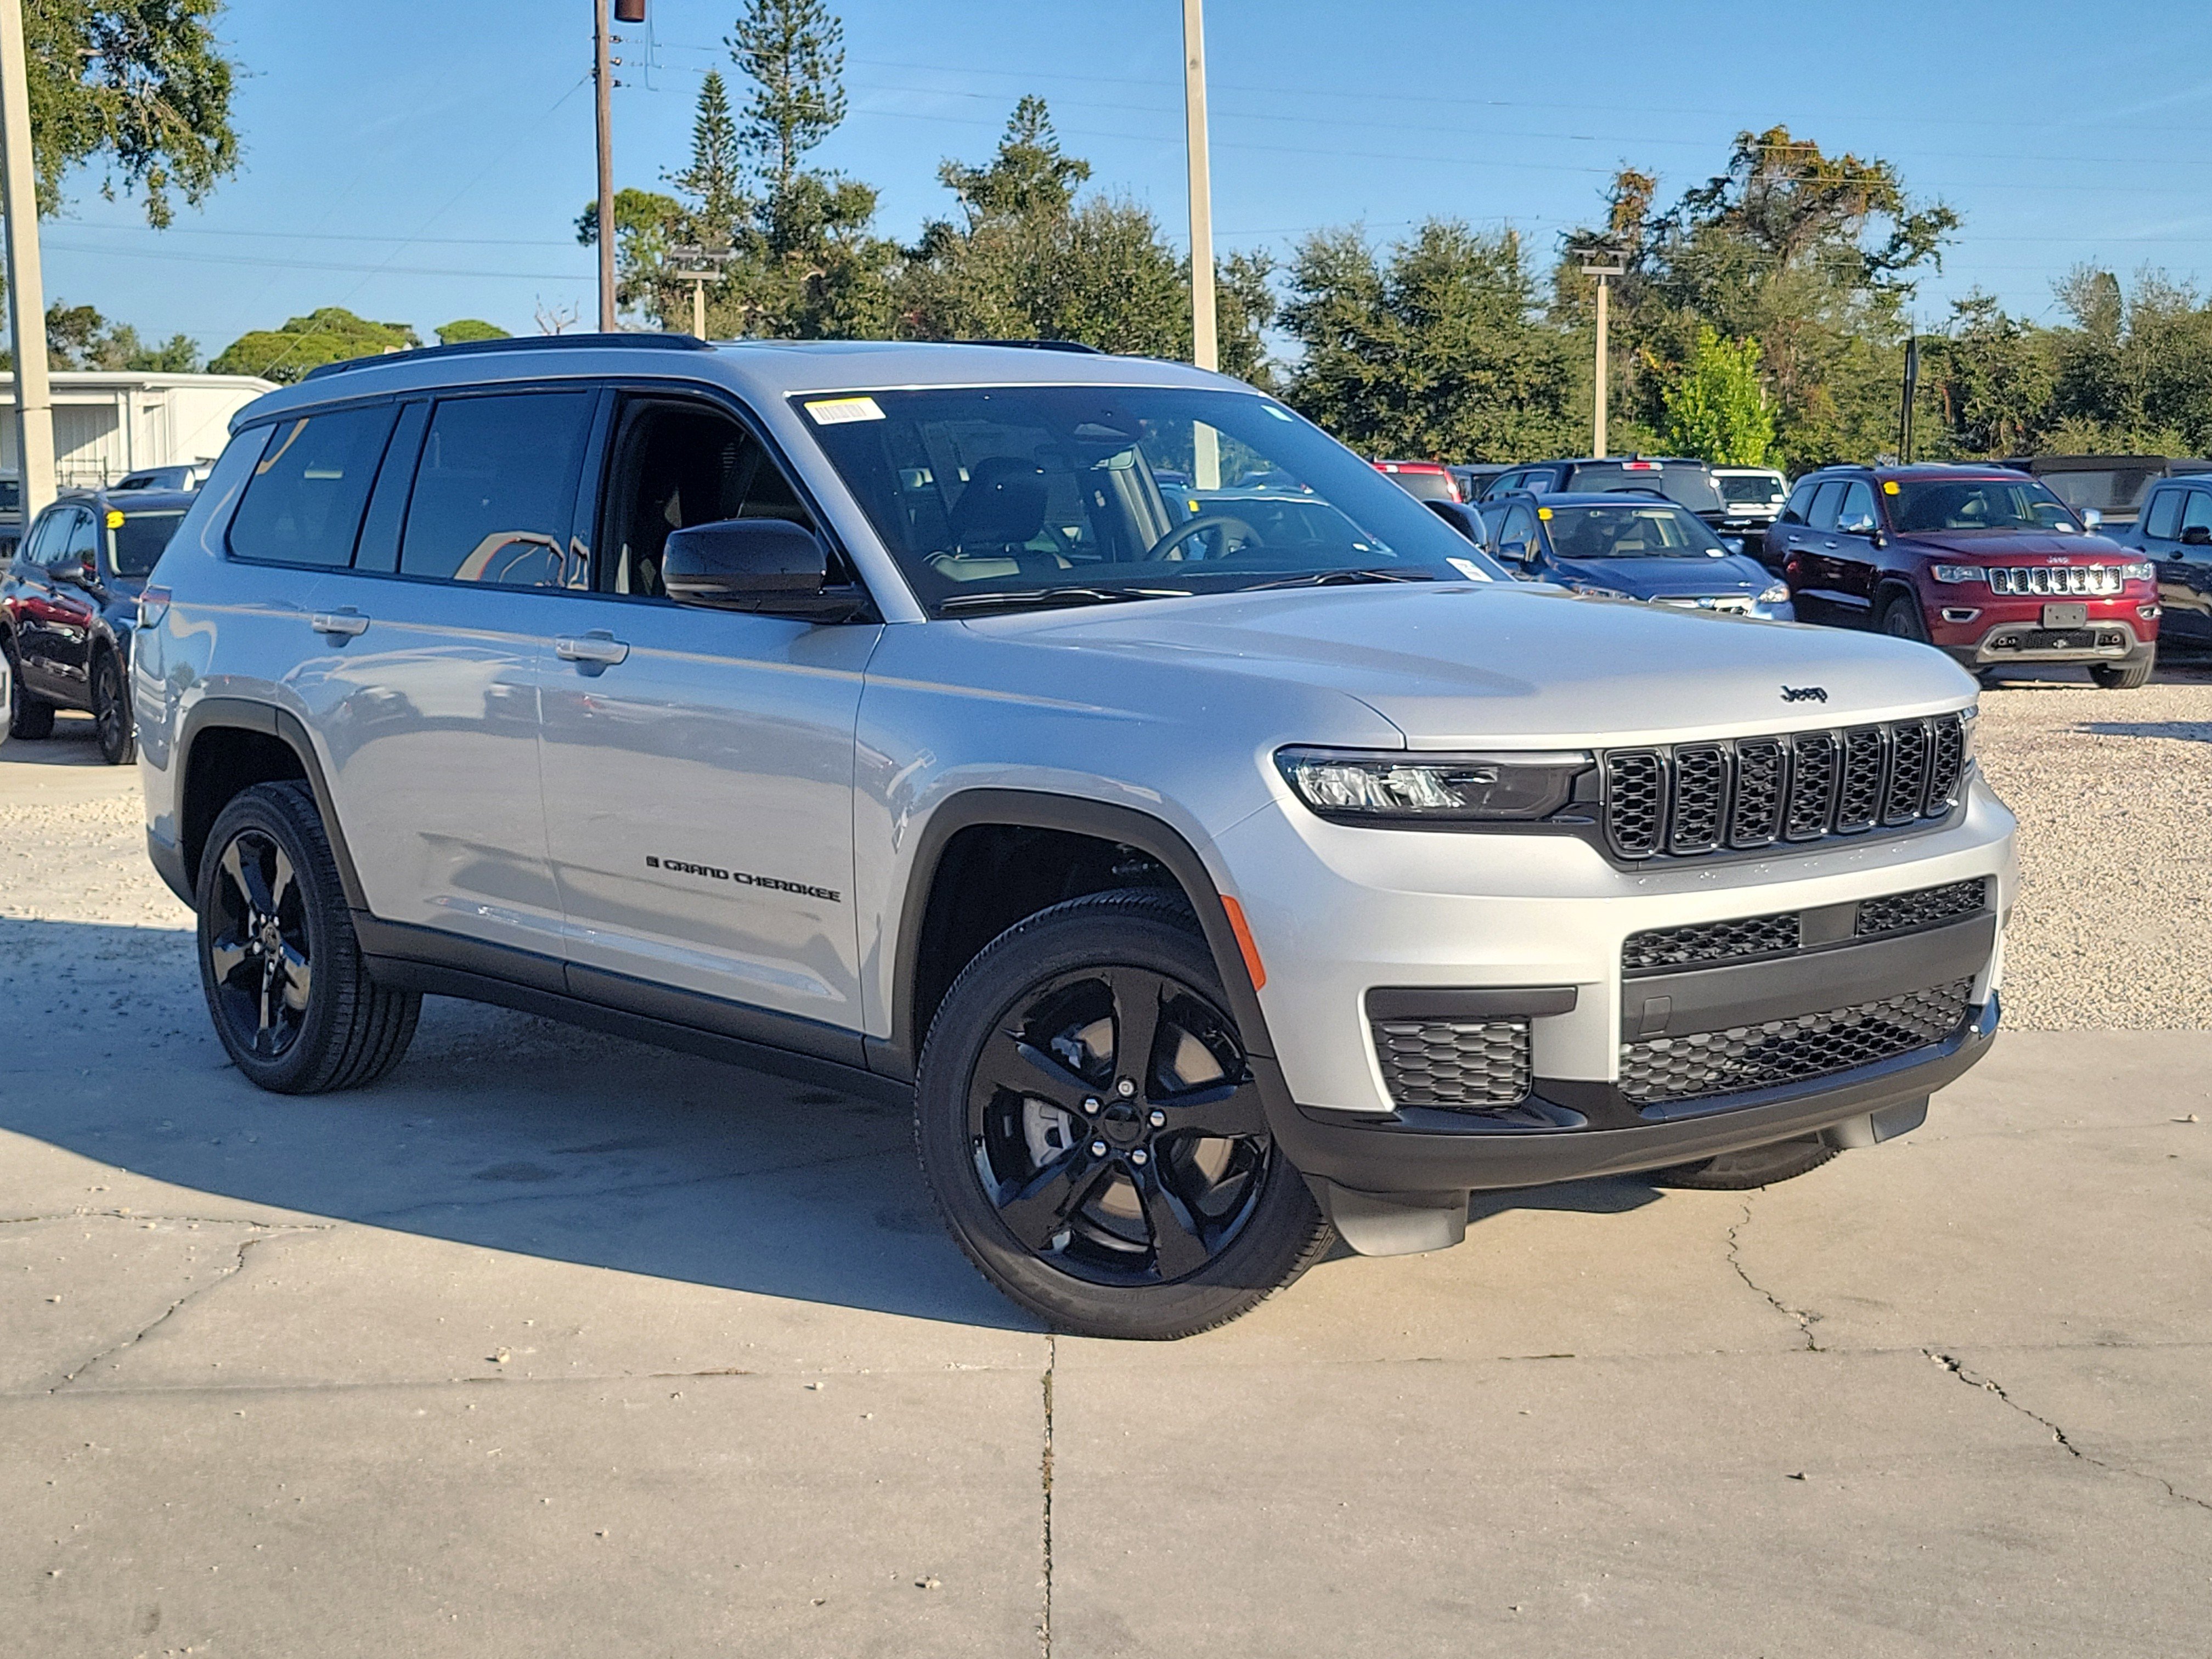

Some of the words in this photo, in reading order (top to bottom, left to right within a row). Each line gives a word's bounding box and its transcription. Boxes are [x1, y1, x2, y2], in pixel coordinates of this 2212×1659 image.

[1780, 685, 1828, 703] Jeep
[663, 860, 729, 879] GRAND
[733, 872, 841, 902] CHEROKEE
